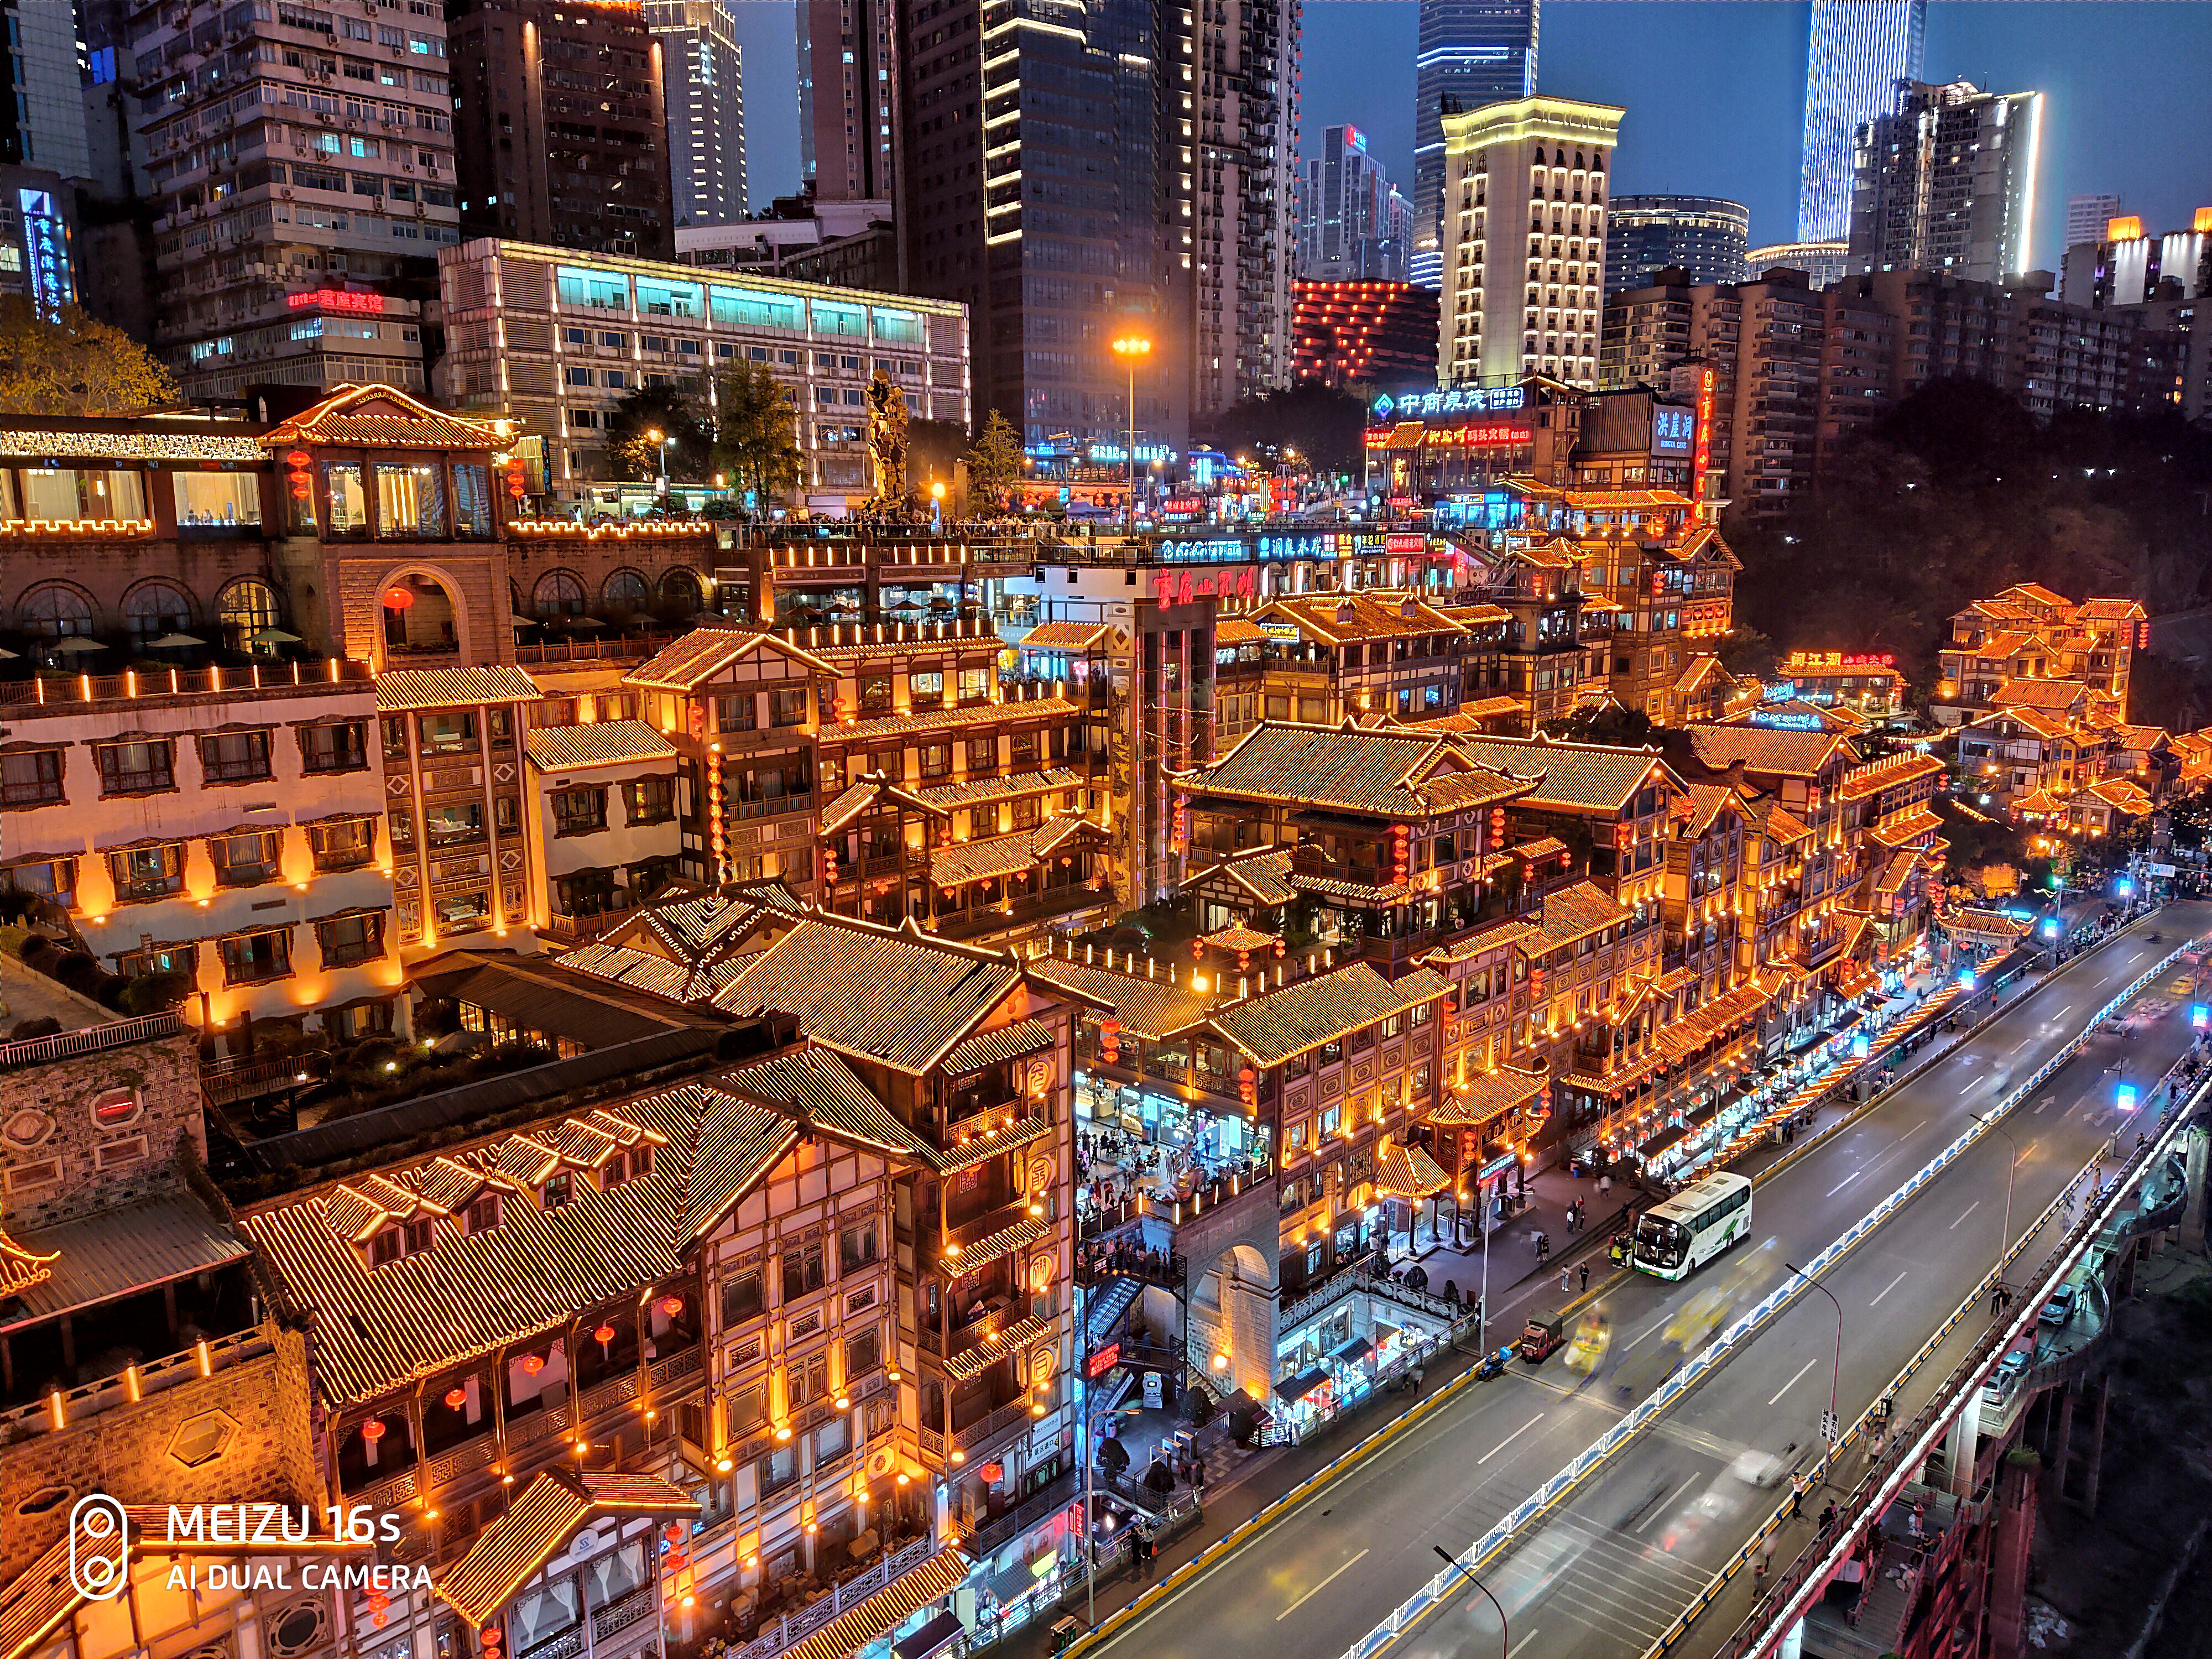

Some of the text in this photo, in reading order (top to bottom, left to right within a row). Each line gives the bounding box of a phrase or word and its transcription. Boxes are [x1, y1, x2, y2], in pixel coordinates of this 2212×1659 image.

[321, 290, 383, 310] 君庭宾馆
[1399, 388, 1486, 414] 中商卓茂
[1658, 411, 1692, 440] 洪崖洞
